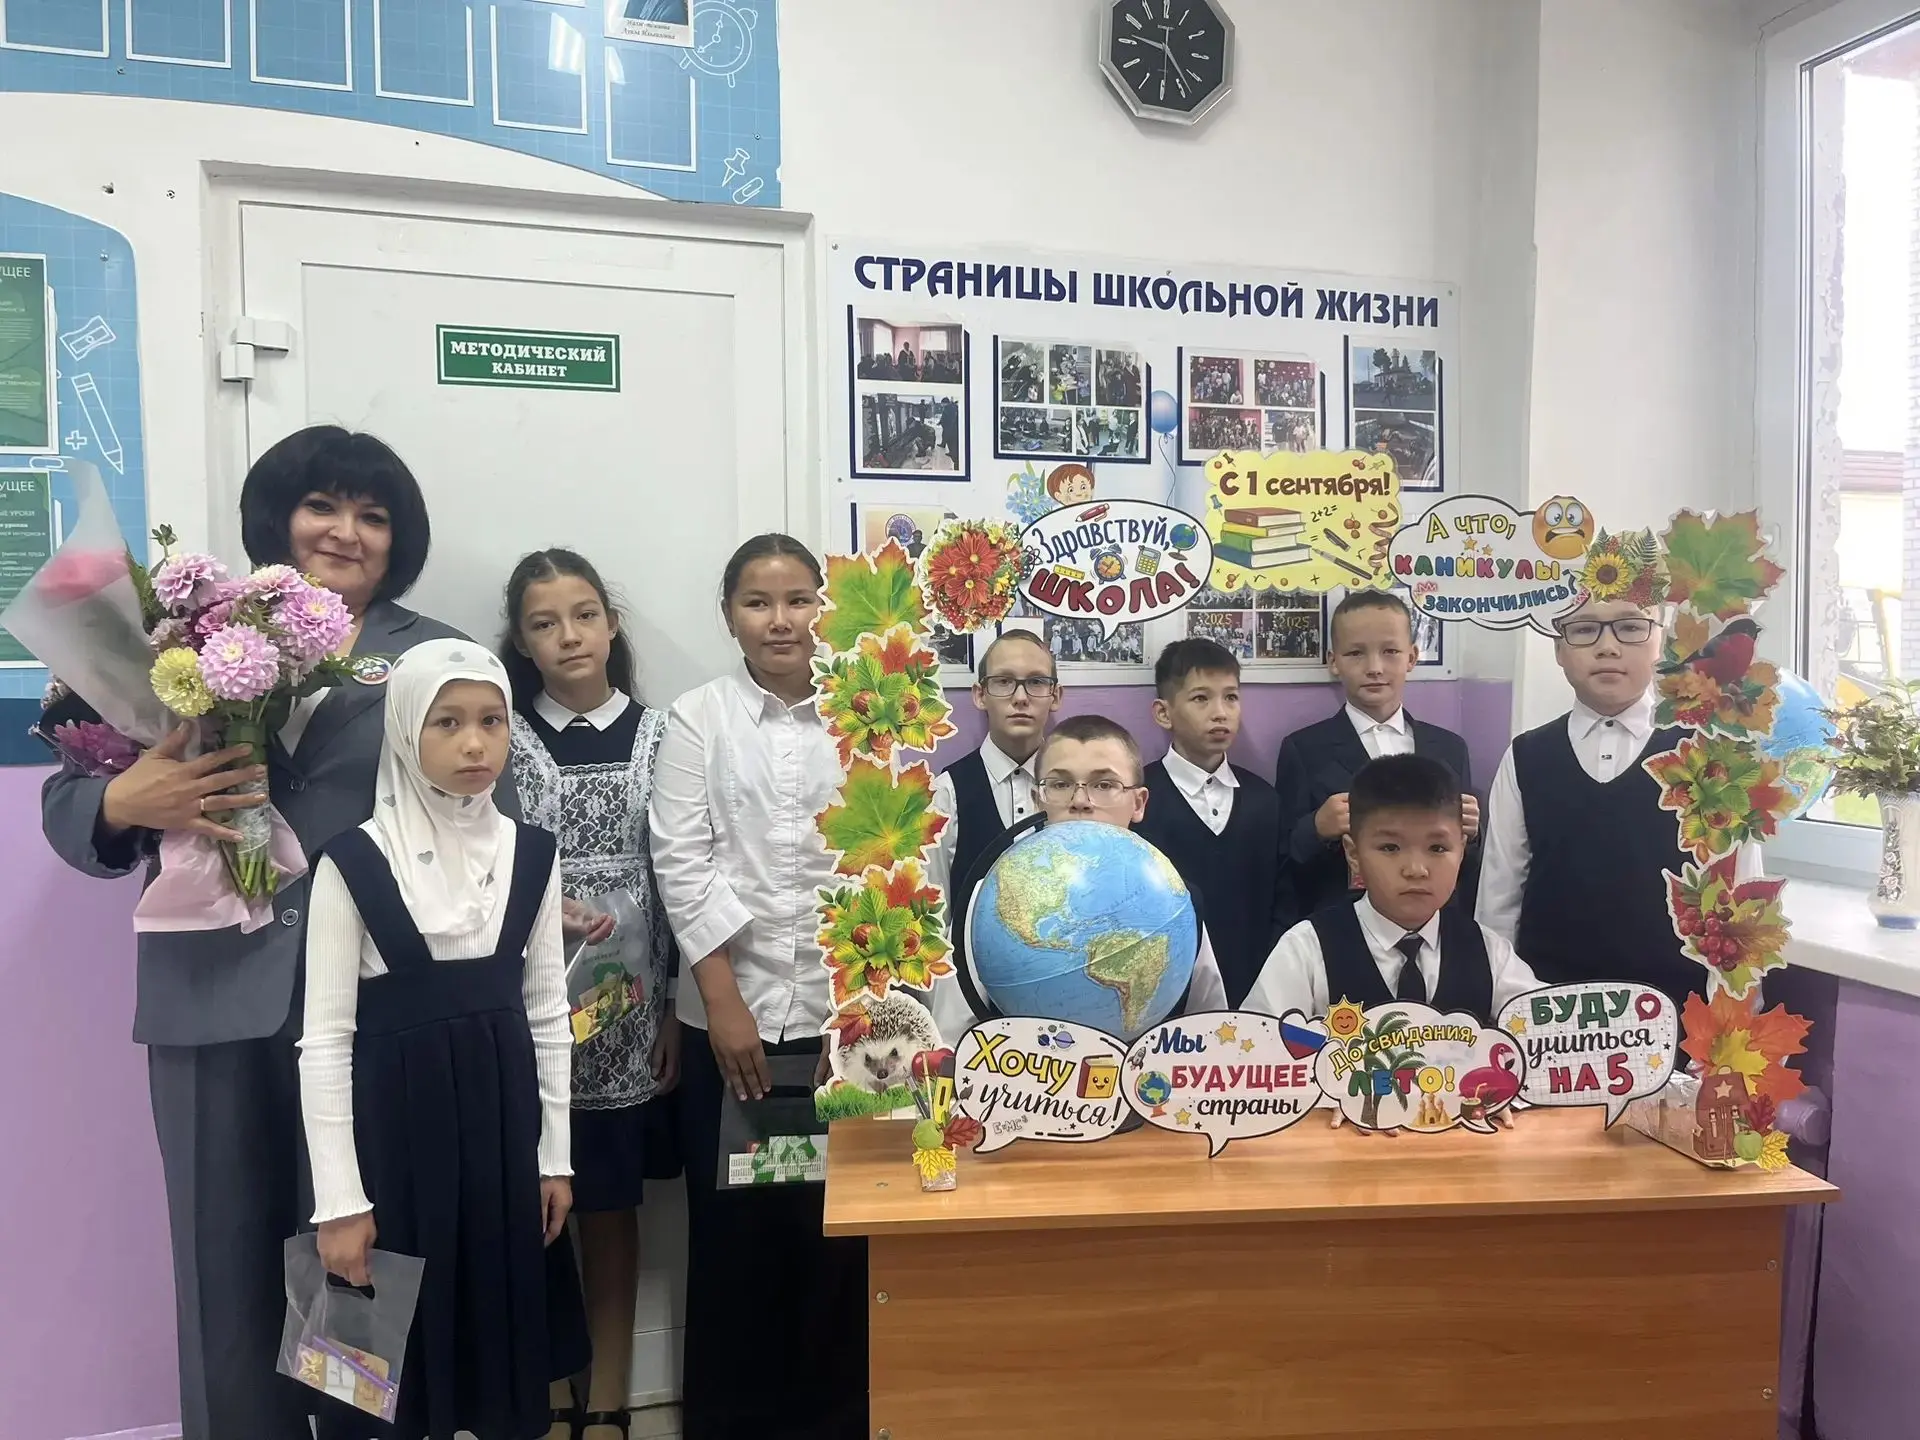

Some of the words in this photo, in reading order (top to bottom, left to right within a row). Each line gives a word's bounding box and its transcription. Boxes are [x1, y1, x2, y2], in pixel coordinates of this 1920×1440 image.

[1178, 9, 1190, 26] 1
[1188, 30, 1205, 40] 2
[1191, 52, 1210, 60] 3
[1138, 72, 1150, 90] 7
[1175, 78, 1186, 99] 5
[854, 255, 1078, 303] СТРАНИЦЫ
[1093, 272, 1304, 319] ШКОЛЬНОЙ
[1315, 288, 1439, 329] ЖИЗНИ
[450, 340, 607, 362] МЕТОДИЧЕСКИЙ
[491, 362, 568, 377] КАБИНЕТ
[1219, 471, 1240, 496] С
[1246, 470, 1258, 495] 1
[1265, 472, 1391, 502] сентября!
[1031, 515, 1171, 565] Здравствуй,
[1425, 512, 1450, 543] А
[1454, 513, 1516, 540] что,
[1394, 554, 1561, 581] КАНИКУЛЫ
[1028, 562, 1201, 615] ШКОЛА!
[1204, 613, 1233, 626] 2025
[1530, 989, 1631, 1030] БУДУ
[1151, 1027, 1207, 1055] Мы
[1368, 1023, 1478, 1054] свидания,
[1527, 1027, 1655, 1069] учиться
[964, 1029, 1077, 1096] Хочу
[1549, 1063, 1600, 1094] НА
[1605, 1053, 1634, 1095] 5
[1171, 1064, 1308, 1093] БУДУЩЕЕ
[1349, 1065, 1456, 1096] ЛЕТО!
[979, 1083, 1123, 1130] учиться!
[1197, 1096, 1302, 1126] страны
